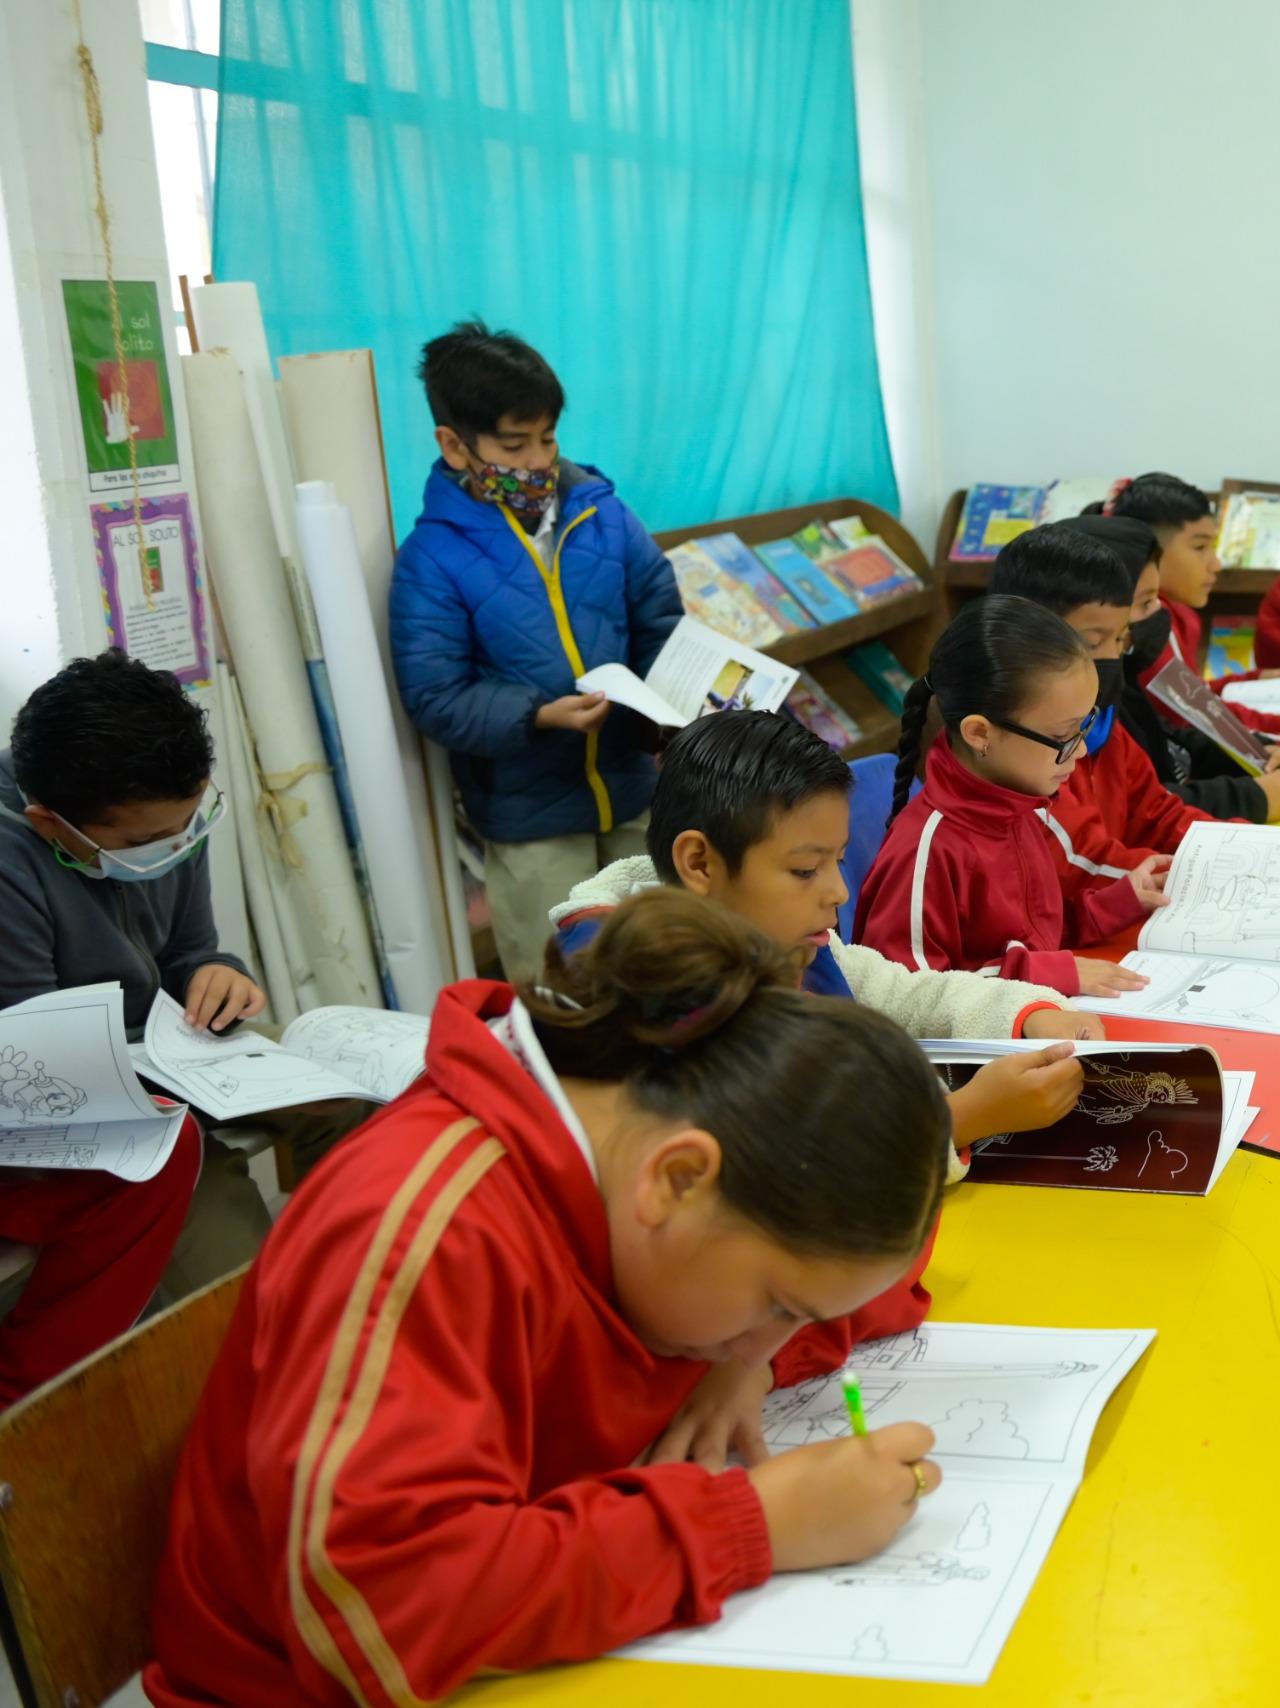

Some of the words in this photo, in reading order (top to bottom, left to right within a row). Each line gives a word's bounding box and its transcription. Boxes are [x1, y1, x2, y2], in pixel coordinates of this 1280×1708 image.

[130, 311, 151, 329] sol
[117, 333, 154, 351] olito
[149, 526, 178, 542] SOLITO
